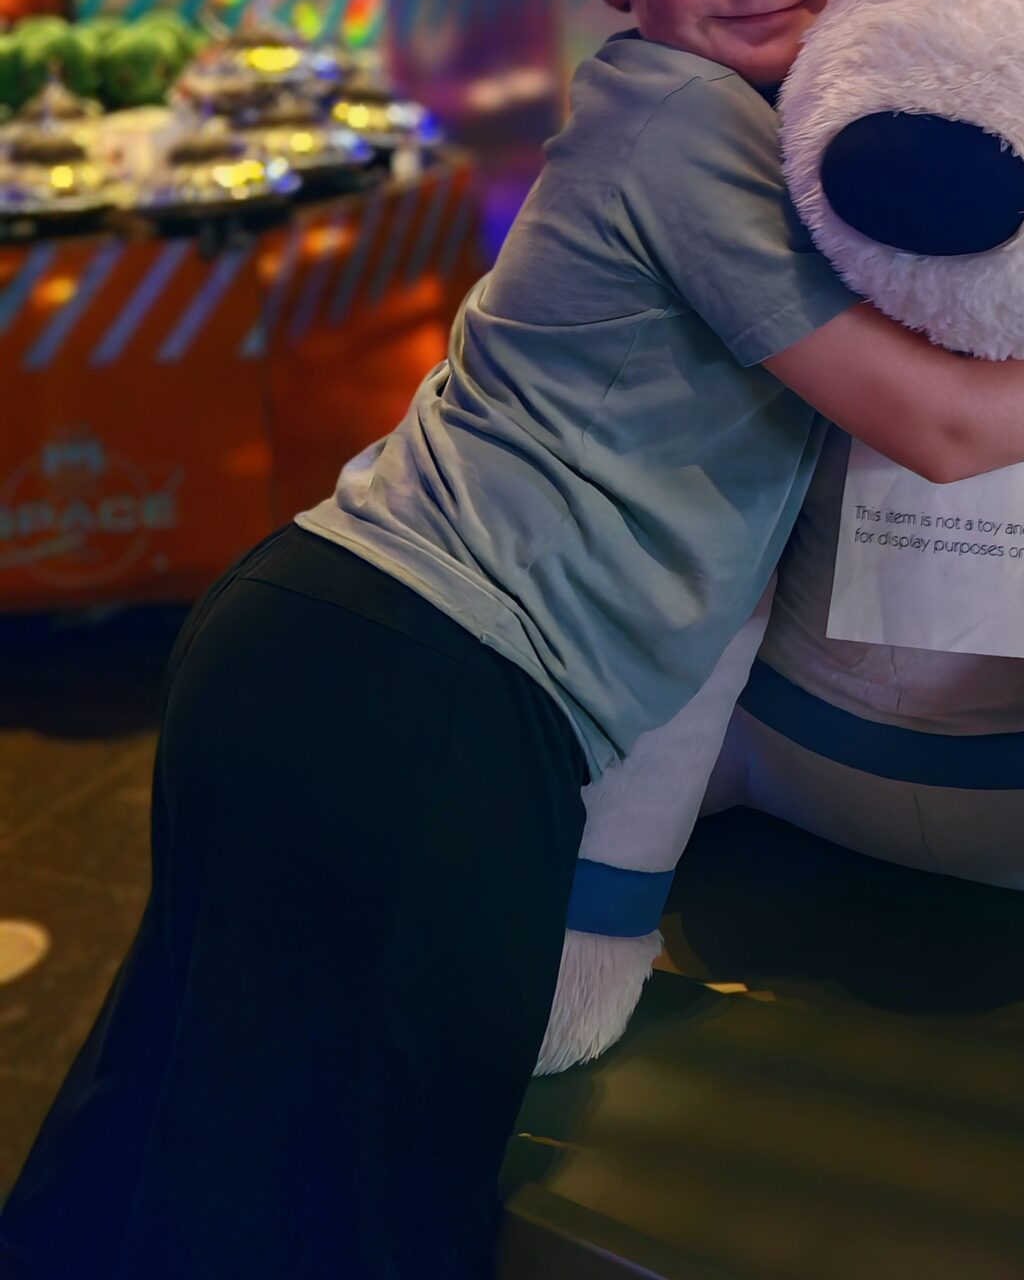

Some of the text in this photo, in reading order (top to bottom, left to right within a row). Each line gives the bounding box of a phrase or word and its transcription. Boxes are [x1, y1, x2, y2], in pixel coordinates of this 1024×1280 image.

[856, 505, 881, 522] This
[886, 509, 916, 525] item
[920, 512, 932, 527] is
[936, 516, 961, 529] not
[964, 519, 973, 531] a
[978, 519, 1003, 536] toy
[855, 528, 875, 543] for
[878, 531, 931, 552] display
[933, 540, 1004, 557] purposes
